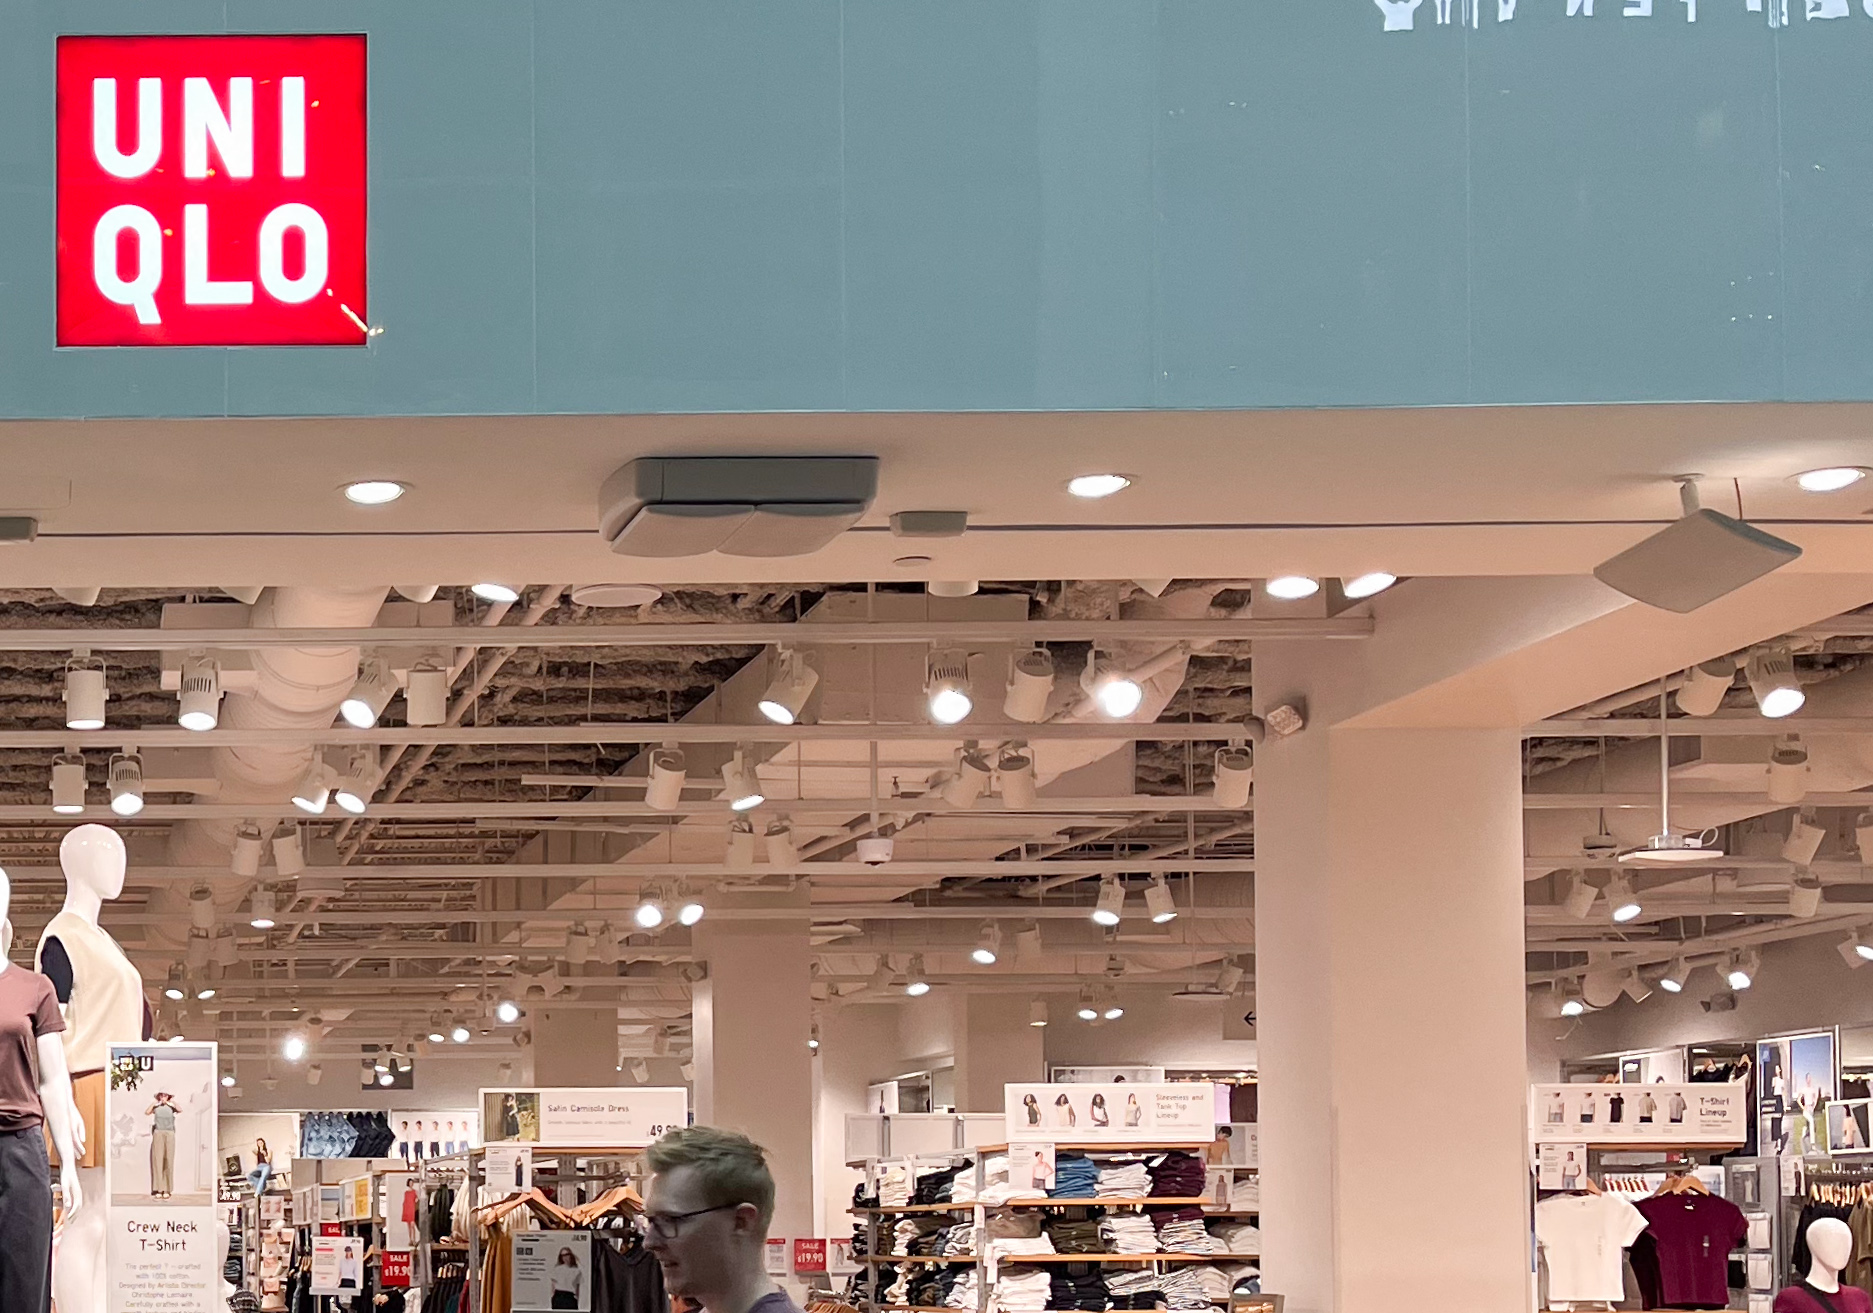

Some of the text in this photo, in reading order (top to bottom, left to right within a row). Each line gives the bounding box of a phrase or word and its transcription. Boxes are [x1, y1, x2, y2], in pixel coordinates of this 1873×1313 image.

[93, 77, 306, 178] UNI
[93, 203, 328, 324] QLO
[1174, 1102, 1187, 1111] Top
[1699, 1097, 1729, 1105] T-Shirt
[547, 1104, 629, 1113] Satin Camisole Dress
[1699, 1107, 1727, 1118] Lineup
[127, 1220, 198, 1233] Crew Neck
[139, 1238, 187, 1251] T-Shirt
[389, 1254, 408, 1262] SALE
